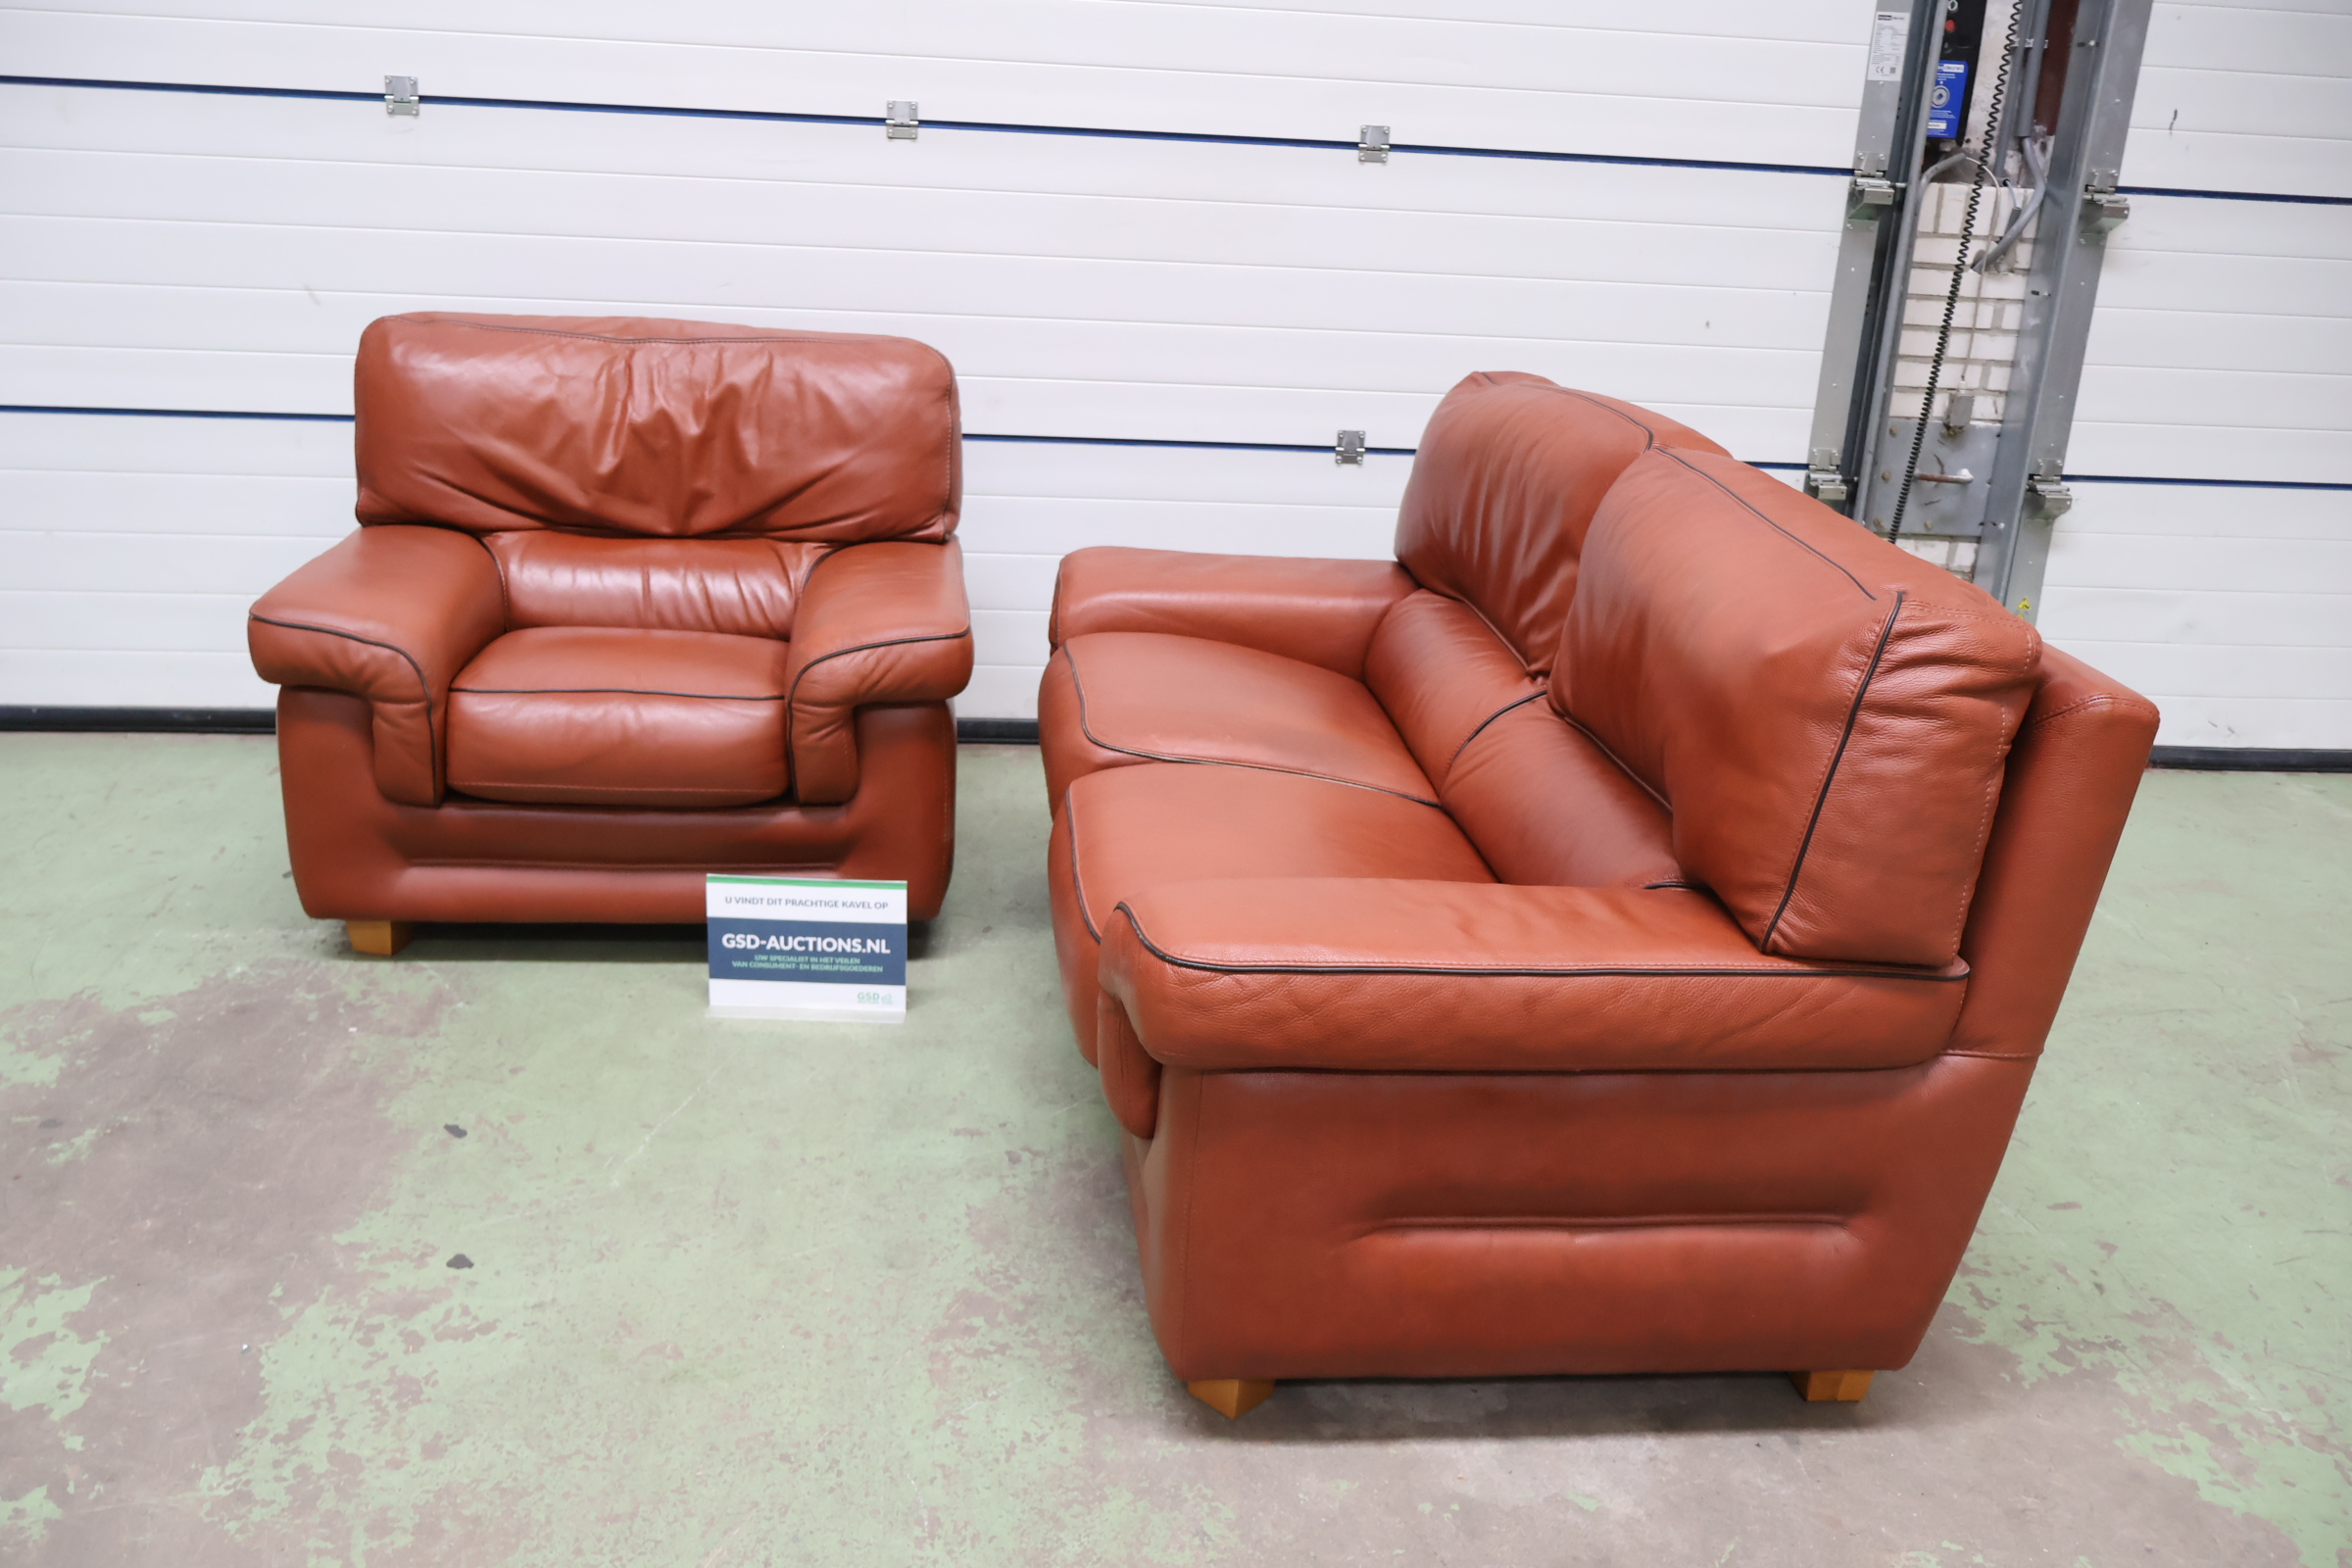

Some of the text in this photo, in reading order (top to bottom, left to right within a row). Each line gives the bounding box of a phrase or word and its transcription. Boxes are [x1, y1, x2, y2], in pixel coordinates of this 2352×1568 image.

[785, 899, 840, 907] PRACHTIGE
[841, 901, 872, 909] KAVEL
[721, 933, 891, 954] GSD-AUCTIONS.NL
[810, 963, 883, 972] BEDRIJFSGOEDEREN
[857, 991, 880, 1001] GSD
